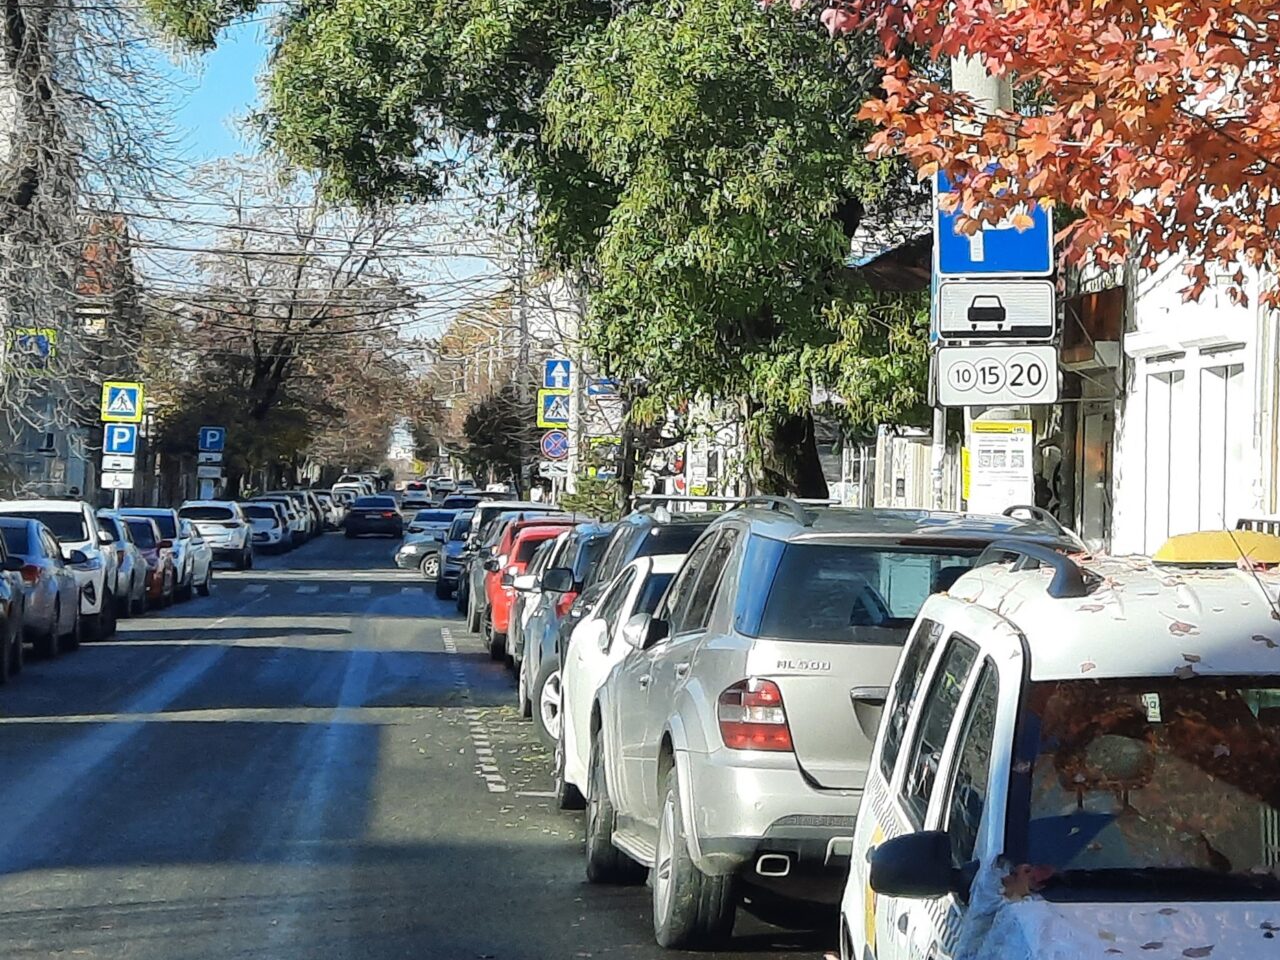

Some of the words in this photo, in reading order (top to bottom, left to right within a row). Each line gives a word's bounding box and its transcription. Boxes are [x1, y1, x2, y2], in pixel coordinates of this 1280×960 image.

[956, 369, 971, 383] 10
[979, 366, 1000, 385] 15
[1010, 363, 1042, 386] 20
[112, 427, 130, 451] P
[205, 430, 220, 448] P
